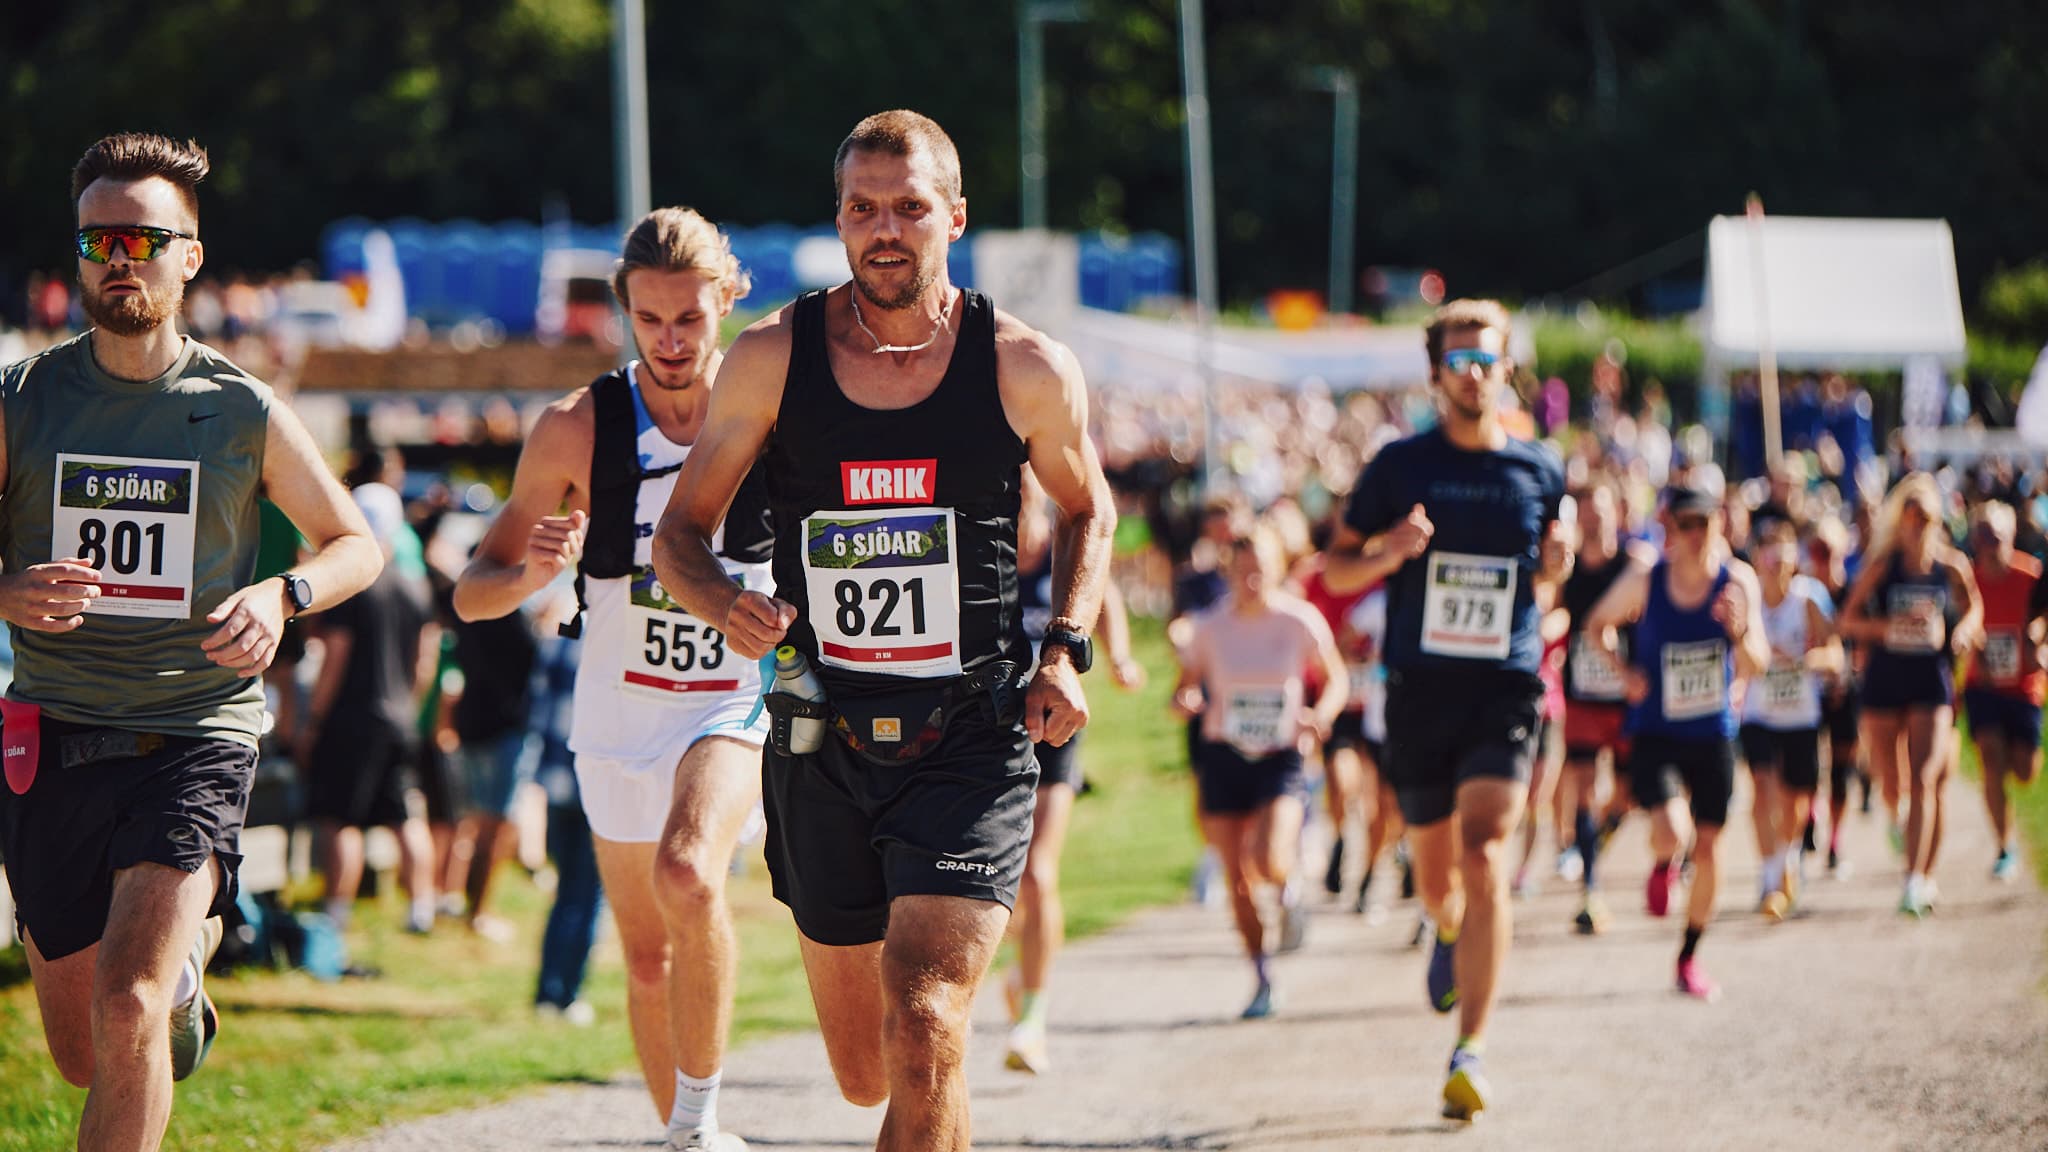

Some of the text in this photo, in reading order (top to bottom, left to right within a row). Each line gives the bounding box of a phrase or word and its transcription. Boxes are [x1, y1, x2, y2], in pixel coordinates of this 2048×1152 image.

[86, 472, 167, 501] 6 SJÖAR
[849, 467, 928, 501] KRIK
[77, 518, 165, 576] 801
[833, 526, 922, 557] 6 SJÖAR
[834, 577, 927, 637] 821
[1443, 598, 1495, 628] 979
[644, 617, 725, 672] 553
[935, 860, 986, 873] CRAFT
